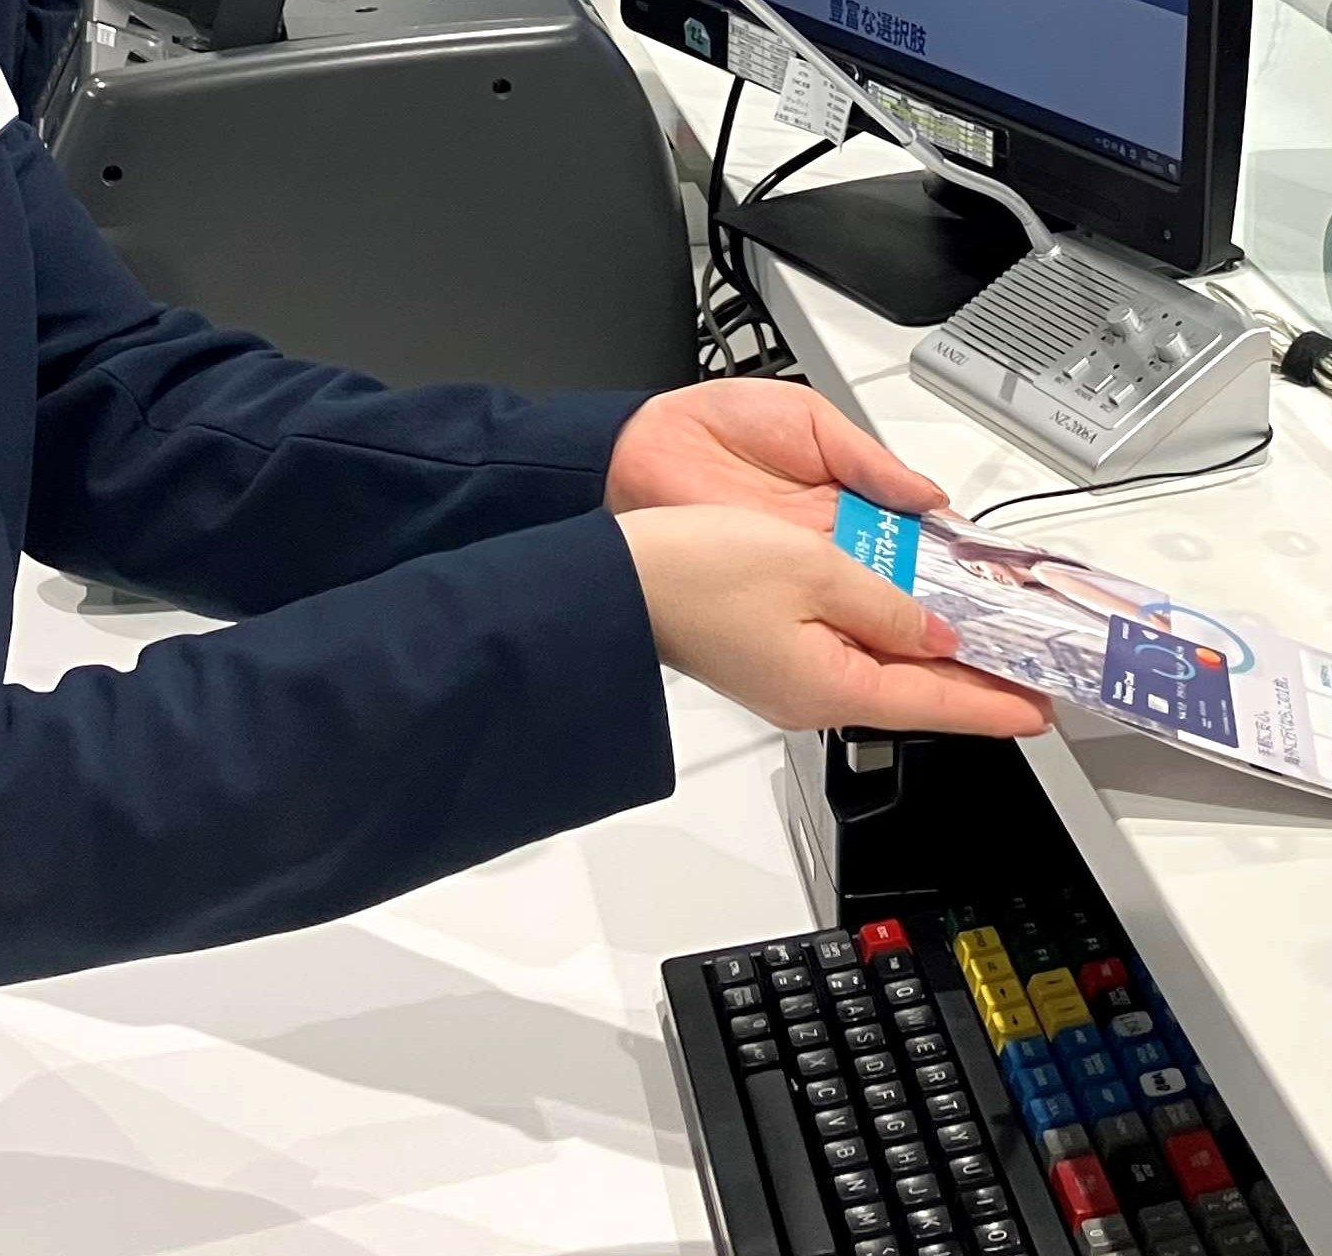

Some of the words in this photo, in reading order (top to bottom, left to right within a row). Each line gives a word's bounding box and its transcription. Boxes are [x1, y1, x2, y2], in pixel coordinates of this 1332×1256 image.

[847, 1005, 865, 1017] A
[799, 1028, 818, 1041] Z
[857, 1031, 876, 1044] S
[809, 1055, 827, 1069] X
[866, 1060, 884, 1072] D
[817, 1087, 836, 1098] C
[875, 1088, 895, 1100] F
[828, 1115, 847, 1126] V
[886, 1119, 906, 1132] G
[917, 1041, 936, 1054] E
[927, 1070, 946, 1084] R
[938, 1100, 959, 1111] T
[950, 1130, 969, 1141] Y
[962, 1161, 983, 1175] U
[976, 1197, 995, 1206] I
[987, 1229, 1008, 1242] O
[835, 1145, 856, 1159] B
[897, 1151, 918, 1165] H
[846, 1178, 867, 1193] N
[908, 1185, 929, 1196] J
[858, 1211, 878, 1227] M
[921, 1215, 942, 1230] K
